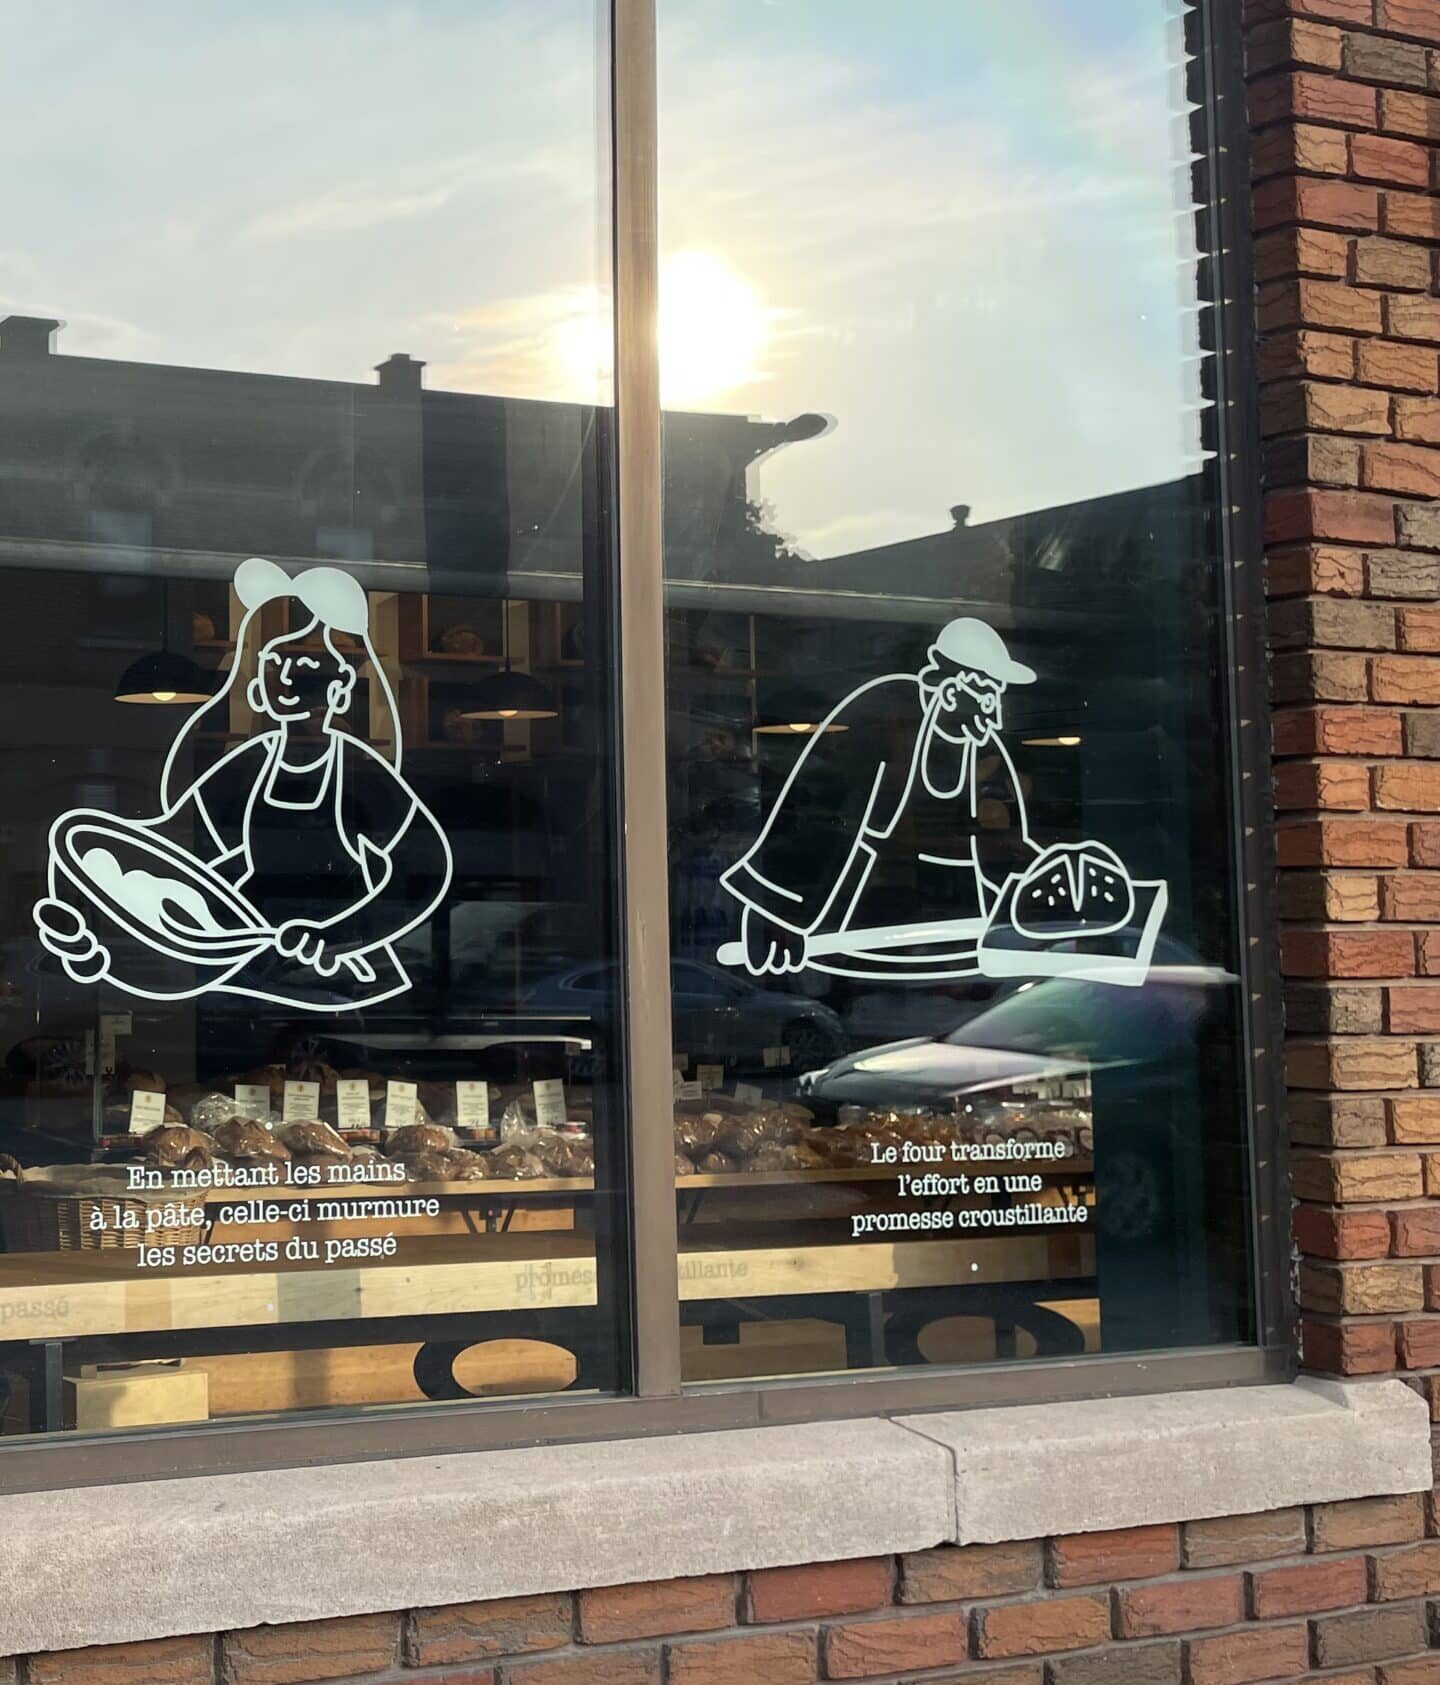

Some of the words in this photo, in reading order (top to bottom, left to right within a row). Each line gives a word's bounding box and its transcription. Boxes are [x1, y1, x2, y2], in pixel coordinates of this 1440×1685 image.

[870, 1142, 897, 1164] Le
[903, 1141, 946, 1162] four
[950, 1138, 1065, 1161] transforme
[126, 1166, 163, 1190] En
[171, 1164, 278, 1189] mettant
[285, 1162, 320, 1186] les
[328, 1161, 405, 1184] mains
[974, 1177, 1000, 1193] en
[1003, 1174, 1042, 1192] une
[90, 1206, 107, 1230] à
[113, 1206, 139, 1230] la
[145, 1202, 211, 1232] pâte,
[219, 1200, 312, 1225] celle-ci
[317, 1197, 439, 1221] murmure
[851, 1210, 954, 1236] promesse
[958, 1203, 1088, 1227] croustillante
[137, 1243, 175, 1268] les
[182, 1241, 278, 1265] secrets
[285, 1236, 318, 1261] du
[325, 1232, 396, 1263] passé
[0, 1296, 69, 1321] passé
